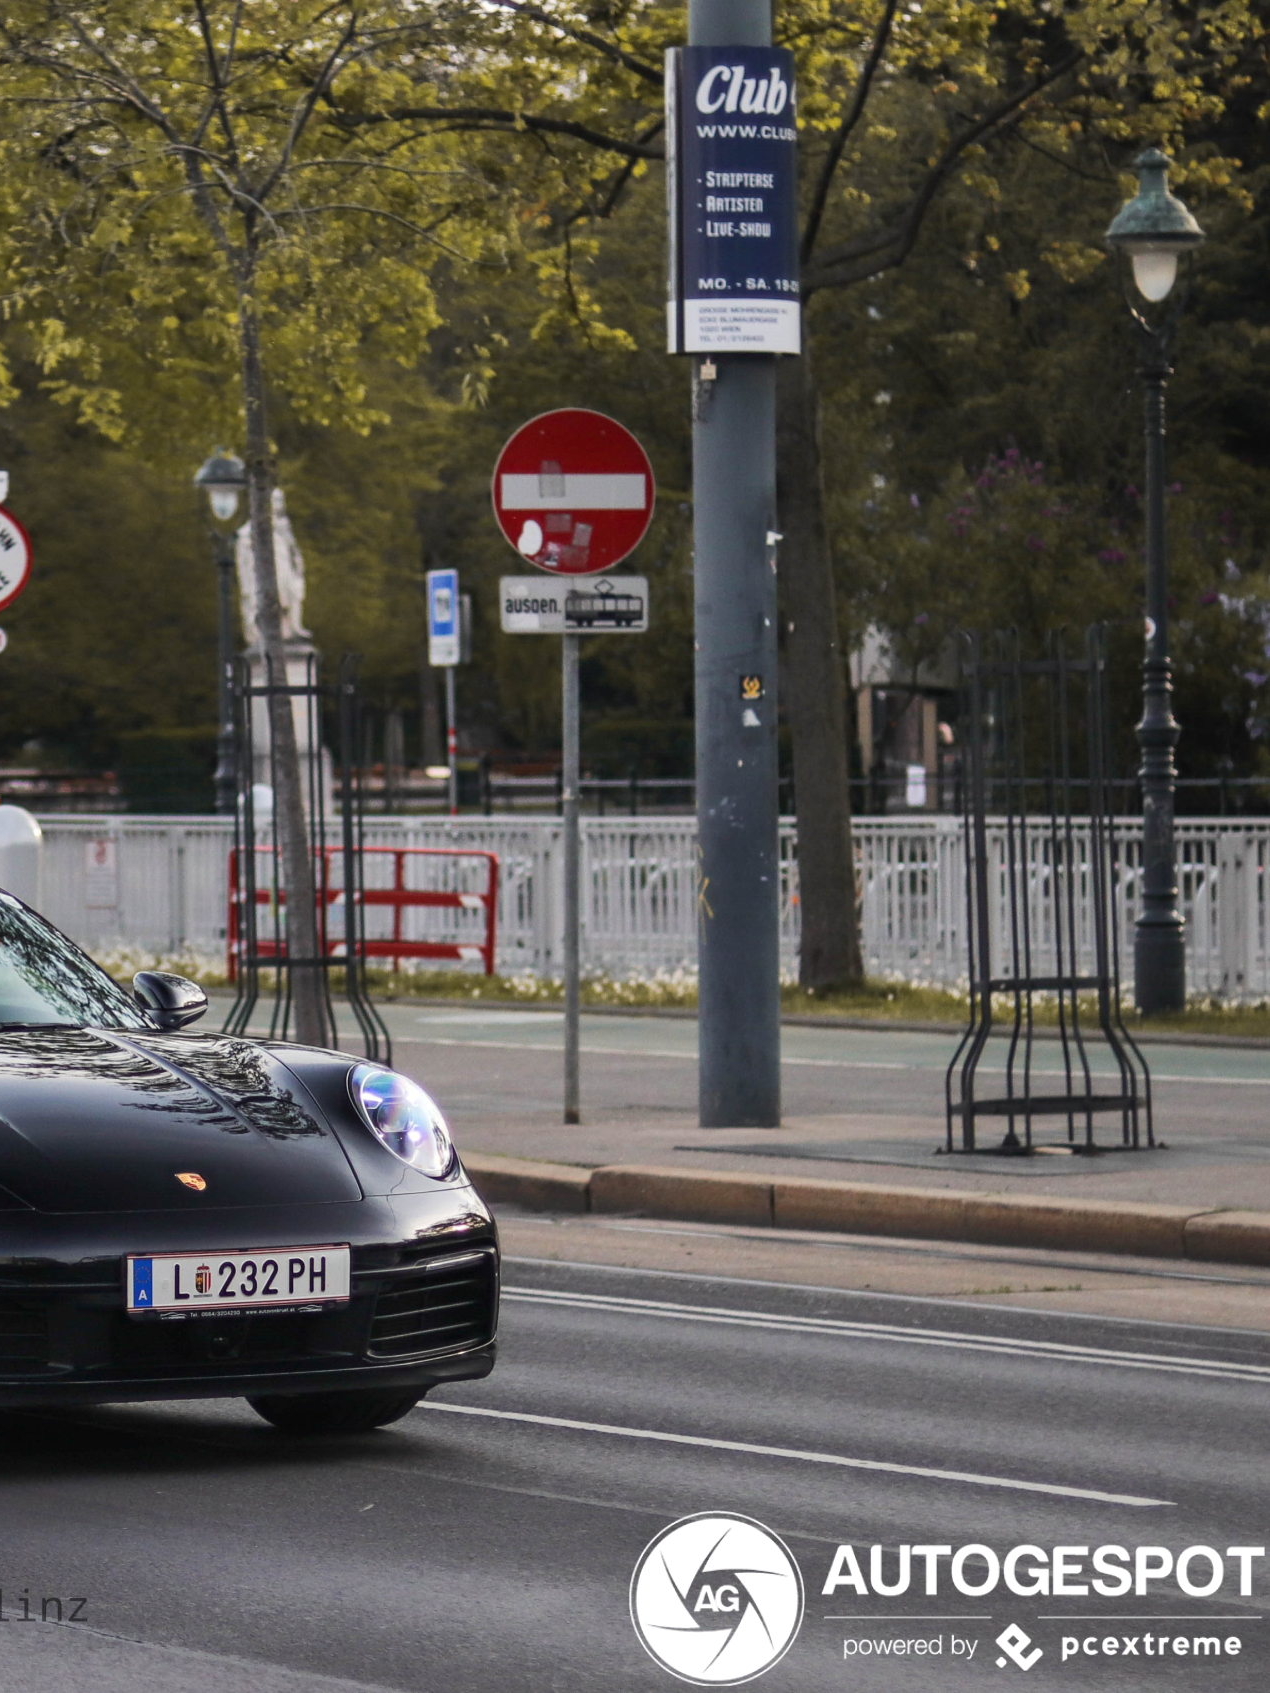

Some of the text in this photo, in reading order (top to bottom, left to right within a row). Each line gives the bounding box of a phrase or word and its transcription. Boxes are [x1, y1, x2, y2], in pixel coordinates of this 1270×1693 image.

[696, 65, 787, 116] Club
[698, 278, 731, 291] MO.
[745, 278, 771, 291] SA.
[175, 1256, 327, 1300] L 232 PH
[138, 1289, 148, 1301] A
